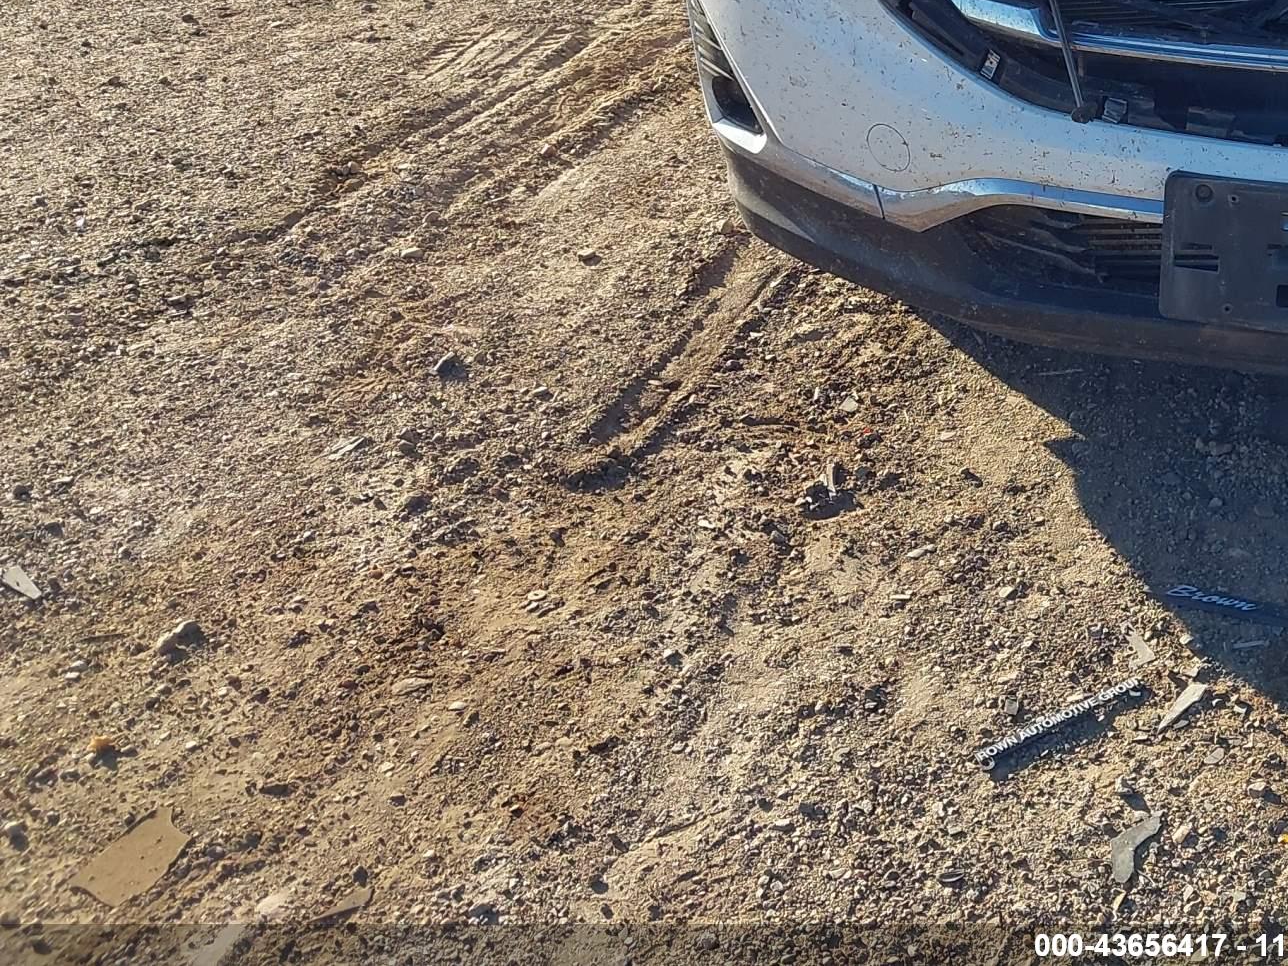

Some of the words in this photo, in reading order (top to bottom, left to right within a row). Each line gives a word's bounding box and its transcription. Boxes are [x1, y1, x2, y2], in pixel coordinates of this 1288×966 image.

[1166, 584, 1258, 611] Brown
[974, 734, 1019, 763] ROWN
[1018, 697, 1099, 743] AUTOMOTIVE
